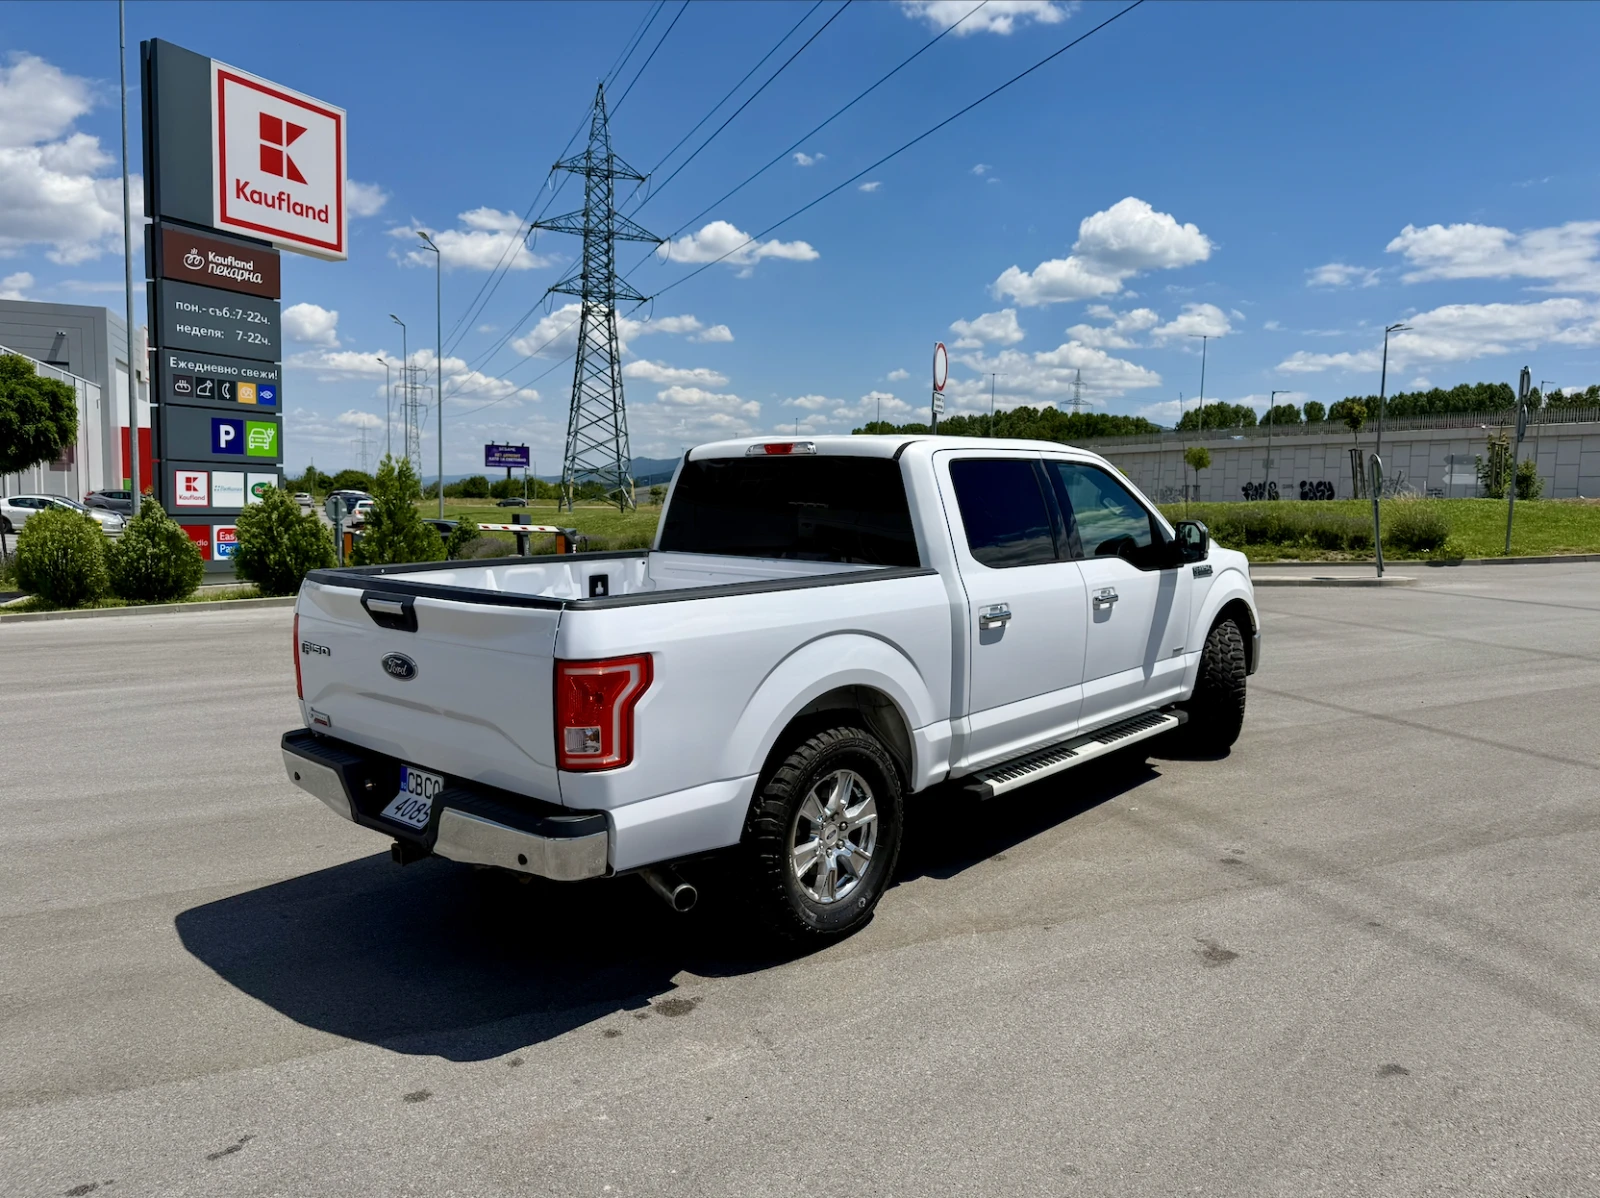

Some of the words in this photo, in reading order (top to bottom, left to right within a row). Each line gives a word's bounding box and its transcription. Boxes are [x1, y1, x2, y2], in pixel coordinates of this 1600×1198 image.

[235, 178, 329, 224] Kaufland
[208, 251, 254, 271] Kaufland
[208, 264, 264, 284] пекарна
[176, 323, 225, 339] неделя:
[235, 330, 271, 345] 7-22ч.
[169, 356, 239, 375] Ежедневно
[241, 368, 278, 380] свежи!
[219, 424, 235, 448] P
[178, 493, 206, 501] Kaufland
[387, 657, 408, 676] Ford
